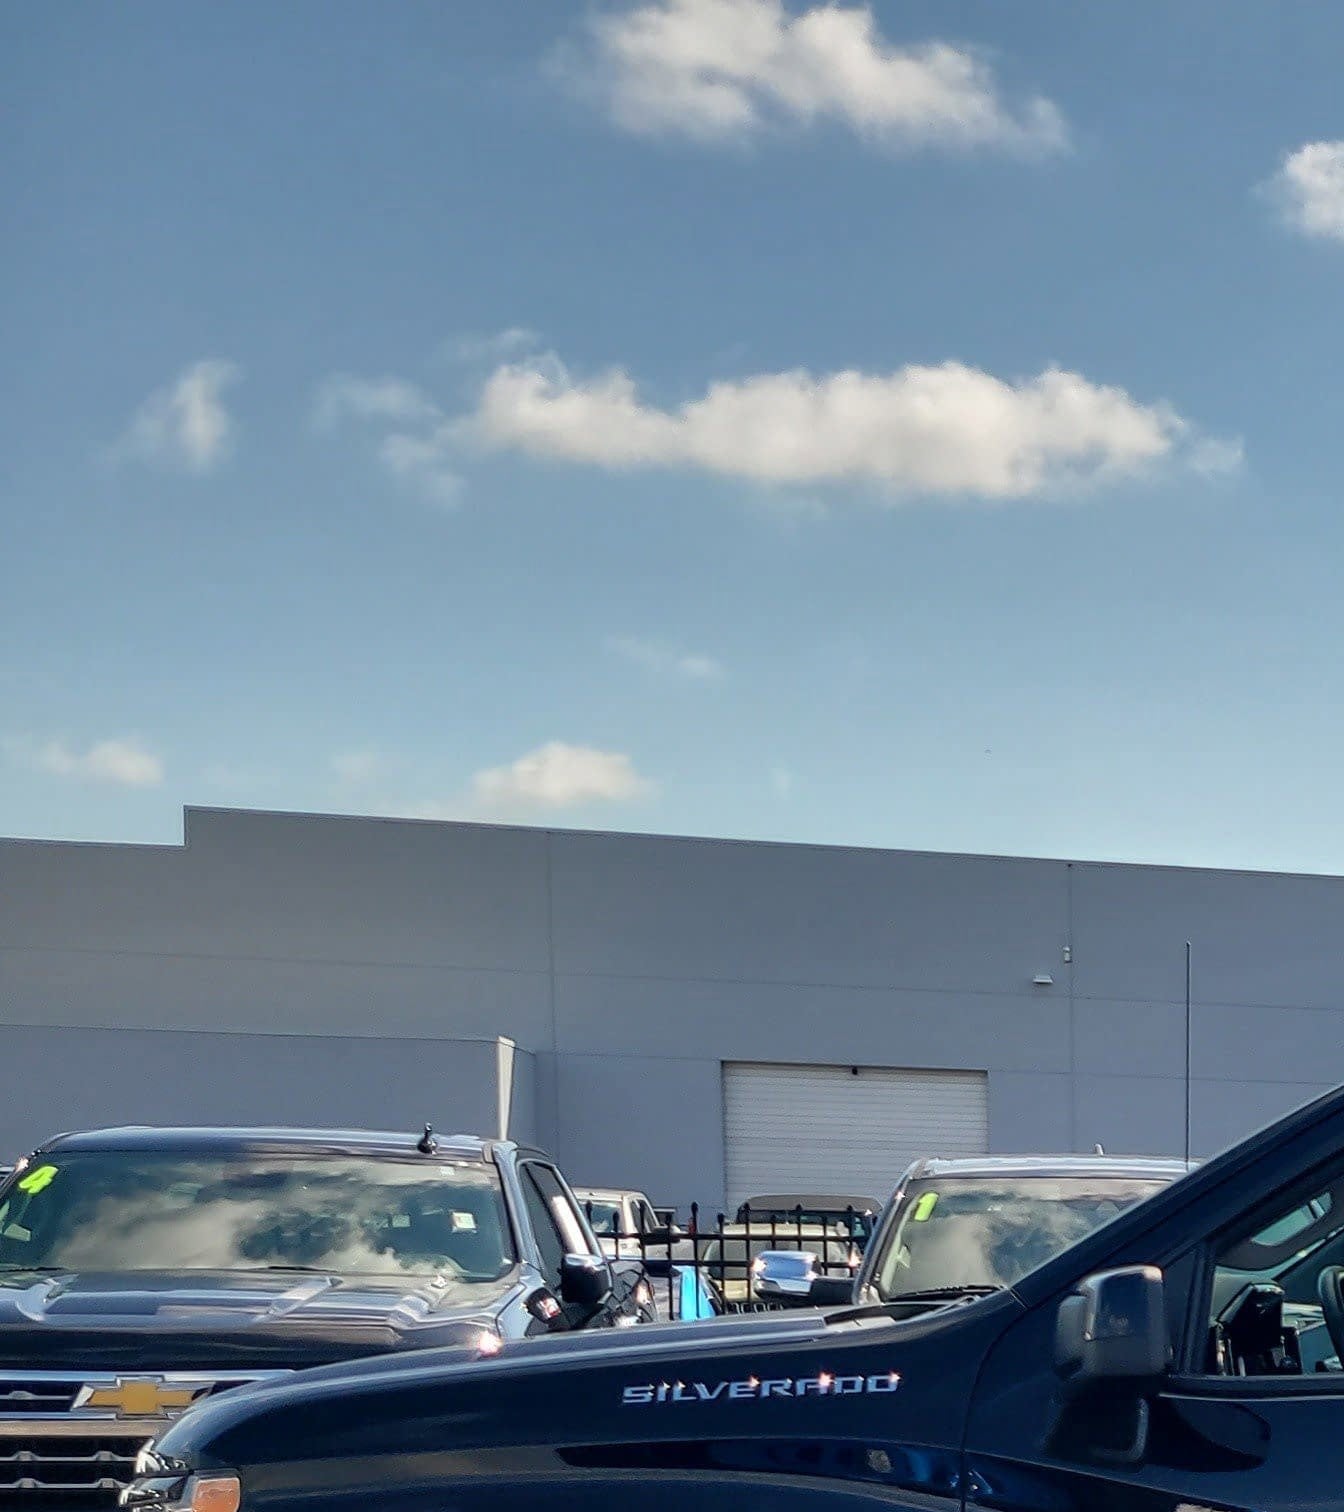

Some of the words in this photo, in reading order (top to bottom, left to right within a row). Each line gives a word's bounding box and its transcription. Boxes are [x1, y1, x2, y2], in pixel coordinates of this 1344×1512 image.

[18, 1166, 59, 1194] 4
[914, 1192, 939, 1221] 1
[622, 1374, 900, 1403] SILVERADO
